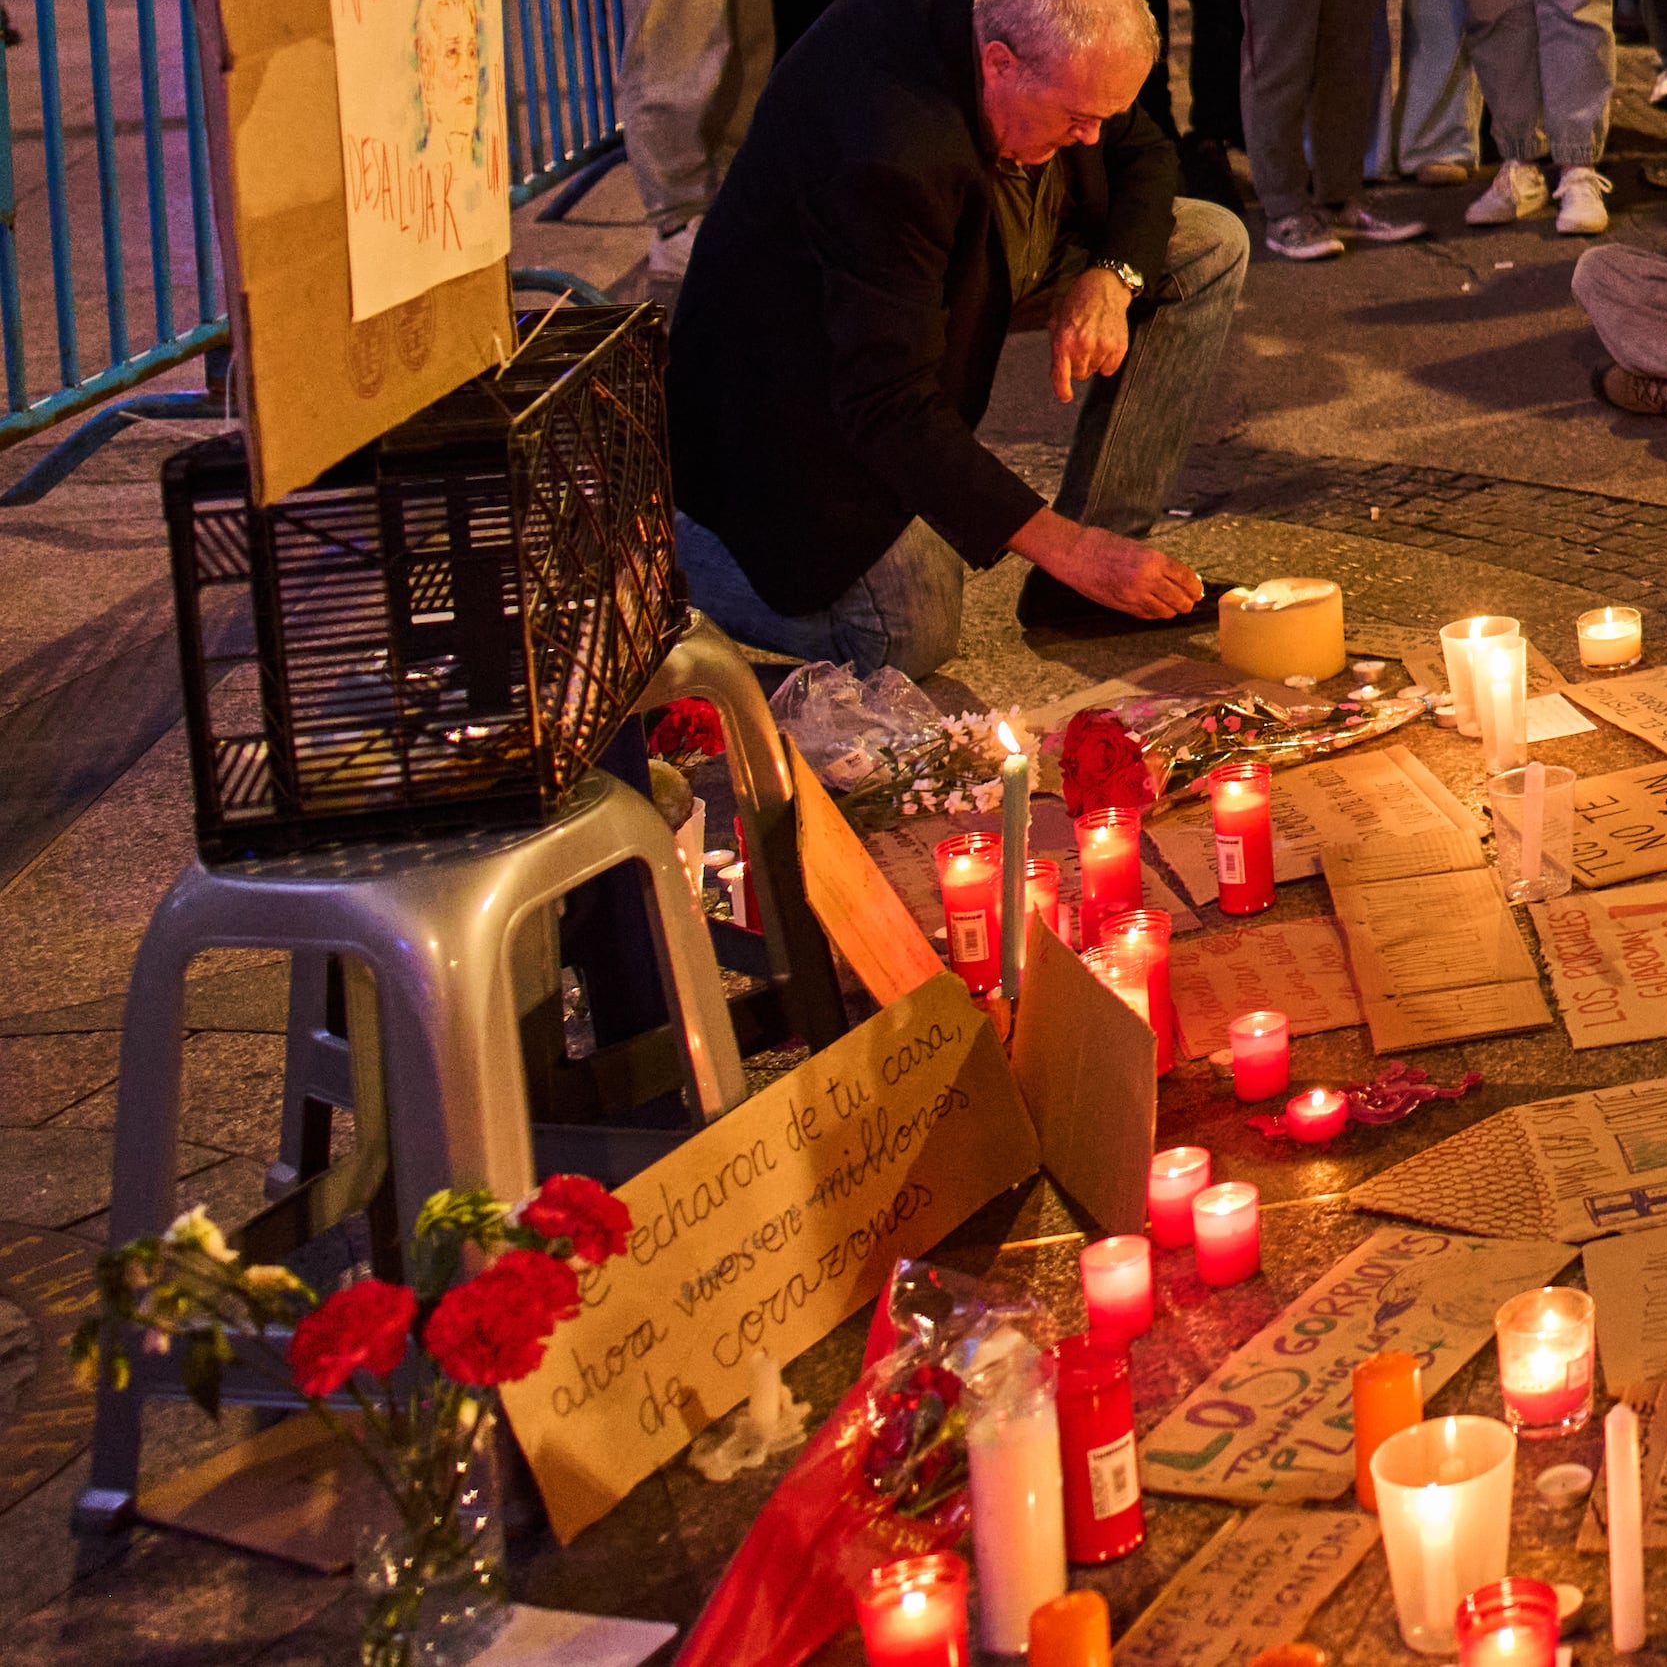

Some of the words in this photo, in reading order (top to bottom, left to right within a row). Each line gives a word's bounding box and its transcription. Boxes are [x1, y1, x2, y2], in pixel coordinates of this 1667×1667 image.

[347, 135, 462, 251] DESALOJAR
[1582, 685, 1638, 717] TESTIGO
[1635, 717, 1664, 729] EL
[1575, 794, 1625, 824] TE
[1548, 909, 1602, 988] PORTALES
[1572, 989, 1627, 1029] LOS
[630, 1137, 776, 1264] echaron
[785, 1100, 817, 1150] de
[827, 1078, 871, 1123] tu
[882, 1022, 966, 1086] casa,
[1525, 1098, 1578, 1127] SIN
[638, 1374, 693, 1437] de
[713, 1181, 933, 1368] corazones
[1148, 1366, 1312, 1469] LOS
[1265, 1235, 1453, 1354] GORRIONES
[552, 1320, 669, 1417] ahora
[1217, 1355, 1362, 1481] TOMAREMOS
[1353, 1326, 1402, 1352] LAS
[1250, 1518, 1360, 1626] DIGNIDAD
